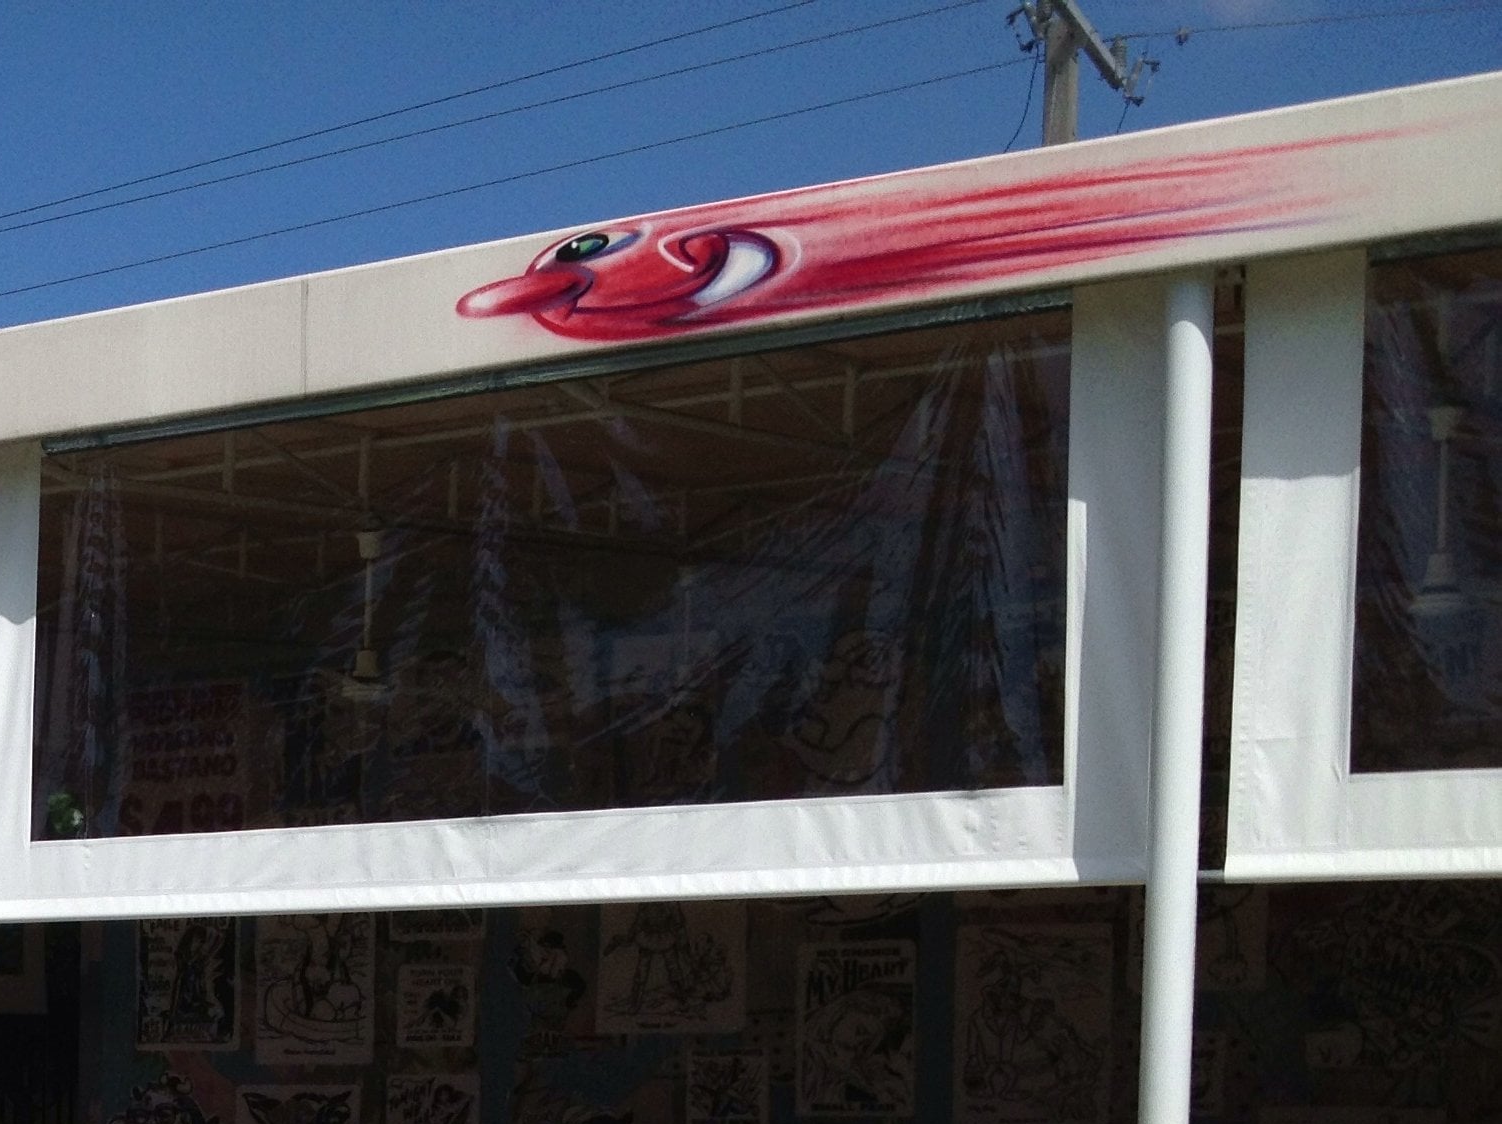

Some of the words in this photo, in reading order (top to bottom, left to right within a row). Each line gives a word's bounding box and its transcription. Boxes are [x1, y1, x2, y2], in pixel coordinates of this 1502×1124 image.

[816, 948, 837, 957] NO
[806, 971, 839, 1009] MY
[843, 959, 908, 992] HEART
